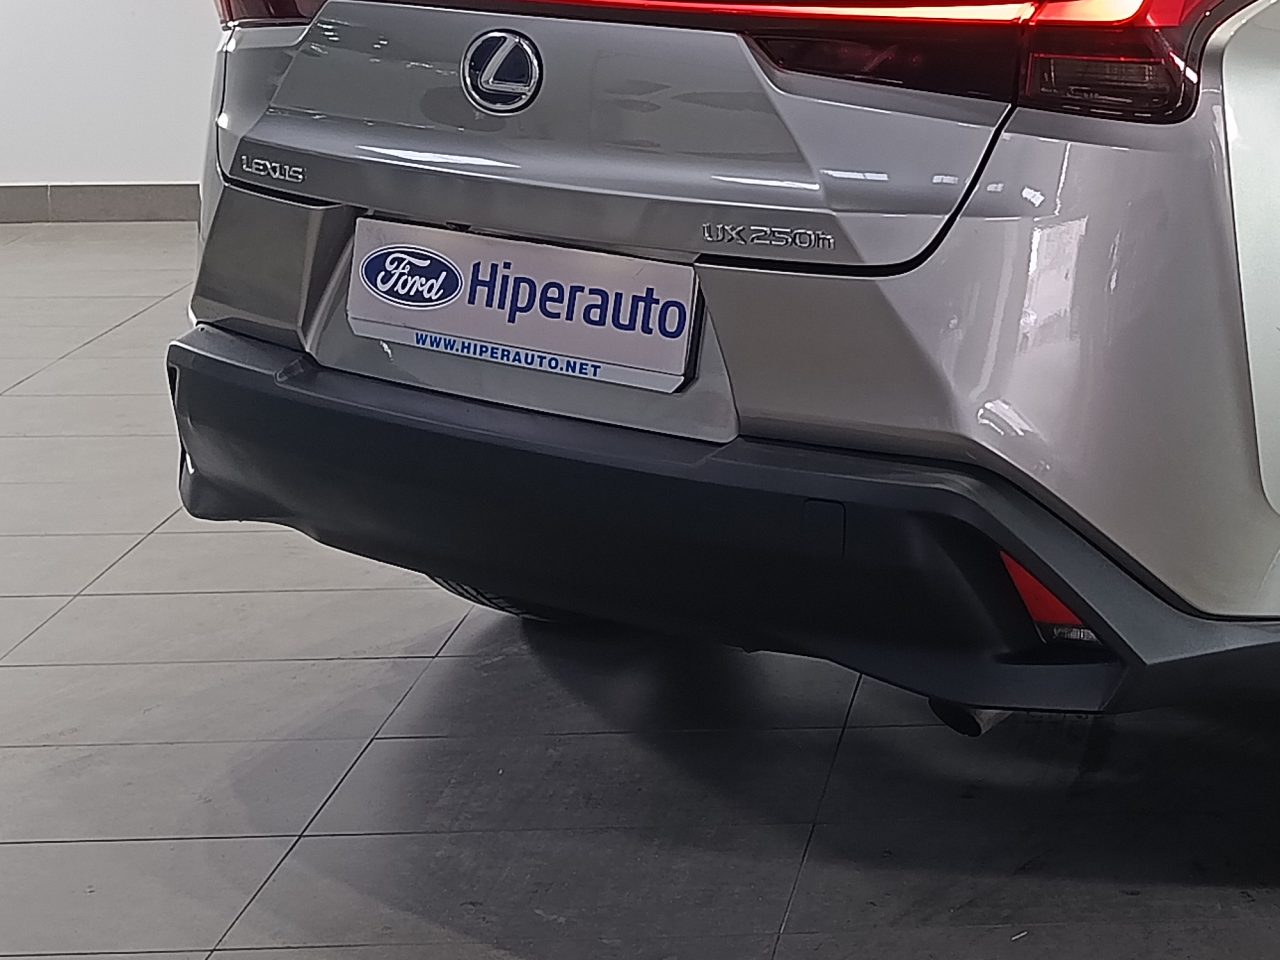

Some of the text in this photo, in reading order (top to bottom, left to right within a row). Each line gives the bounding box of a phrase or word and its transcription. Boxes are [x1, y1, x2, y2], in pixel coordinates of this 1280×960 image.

[240, 154, 305, 183] LEXUS
[376, 251, 688, 340] Ford Hiperauto
[413, 331, 602, 378] WWW.HIPERAUTO.NET
